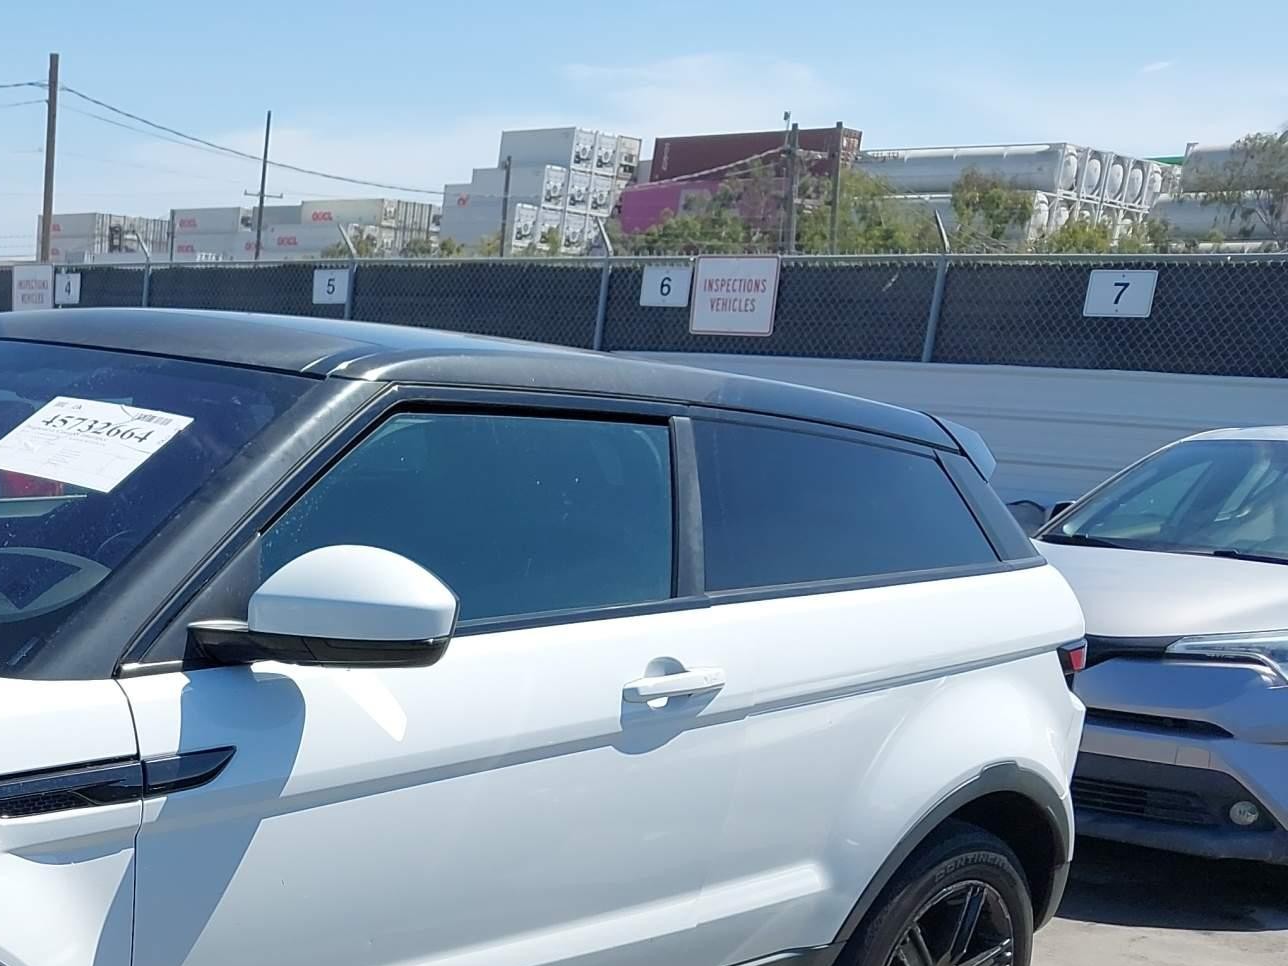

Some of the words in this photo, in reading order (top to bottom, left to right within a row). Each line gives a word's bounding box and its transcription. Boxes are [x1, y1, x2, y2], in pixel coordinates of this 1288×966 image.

[65, 280, 71, 296] 4
[326, 278, 335, 295] 5
[660, 276, 672, 296] 6
[703, 278, 767, 293] INSPECTIONS
[1113, 282, 1130, 305] 7
[710, 297, 756, 313] VEHICLES
[41, 414, 155, 443] 45732664
